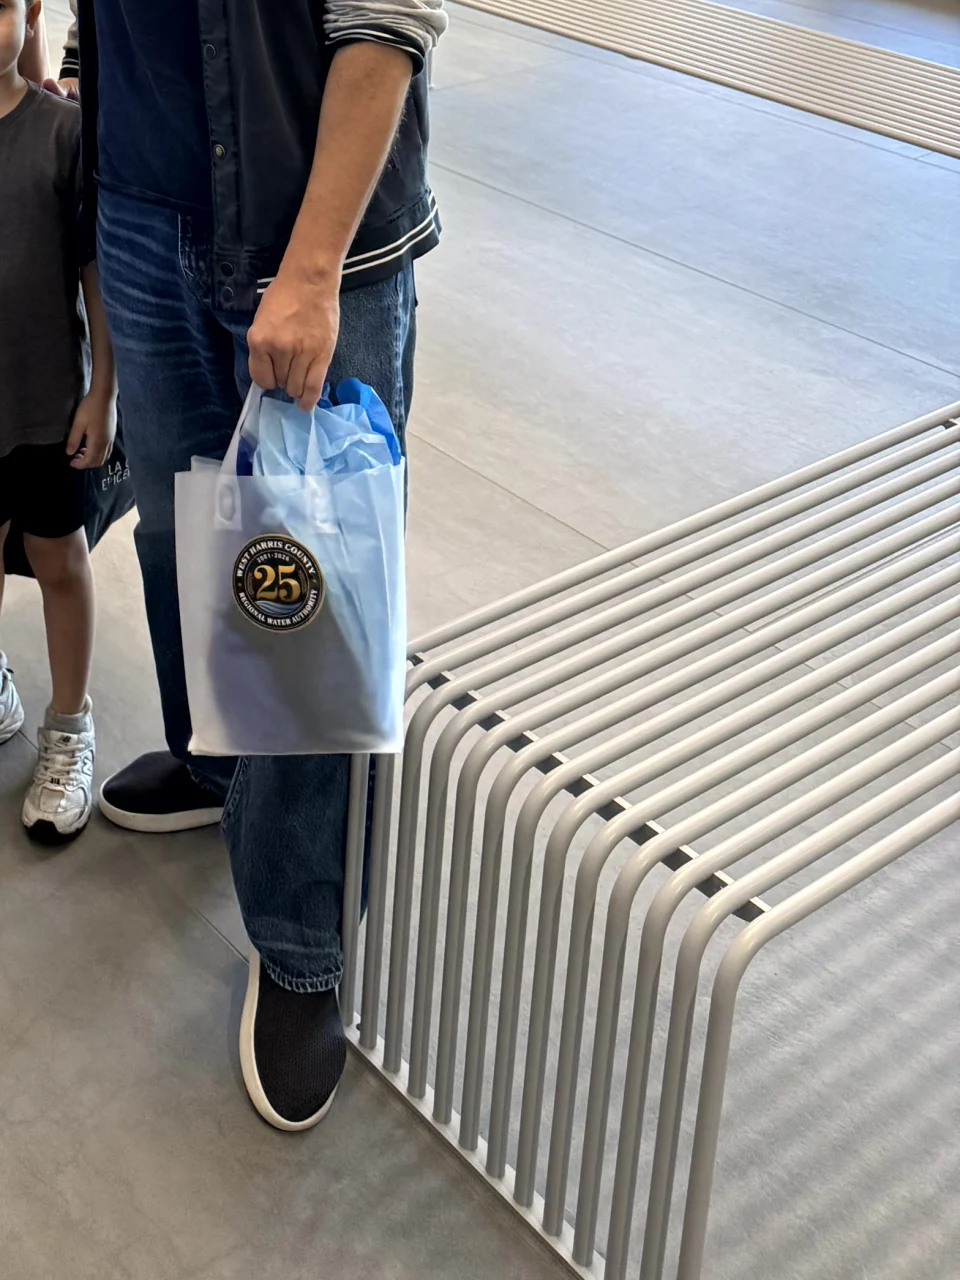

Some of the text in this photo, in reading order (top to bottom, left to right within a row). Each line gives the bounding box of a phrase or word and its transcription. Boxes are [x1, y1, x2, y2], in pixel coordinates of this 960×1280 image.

[236, 540, 316, 577] WEST HARRIS COUNTY
[253, 563, 301, 603] 25
[238, 588, 318, 626] REGIONAL WATER AUTHORITY
